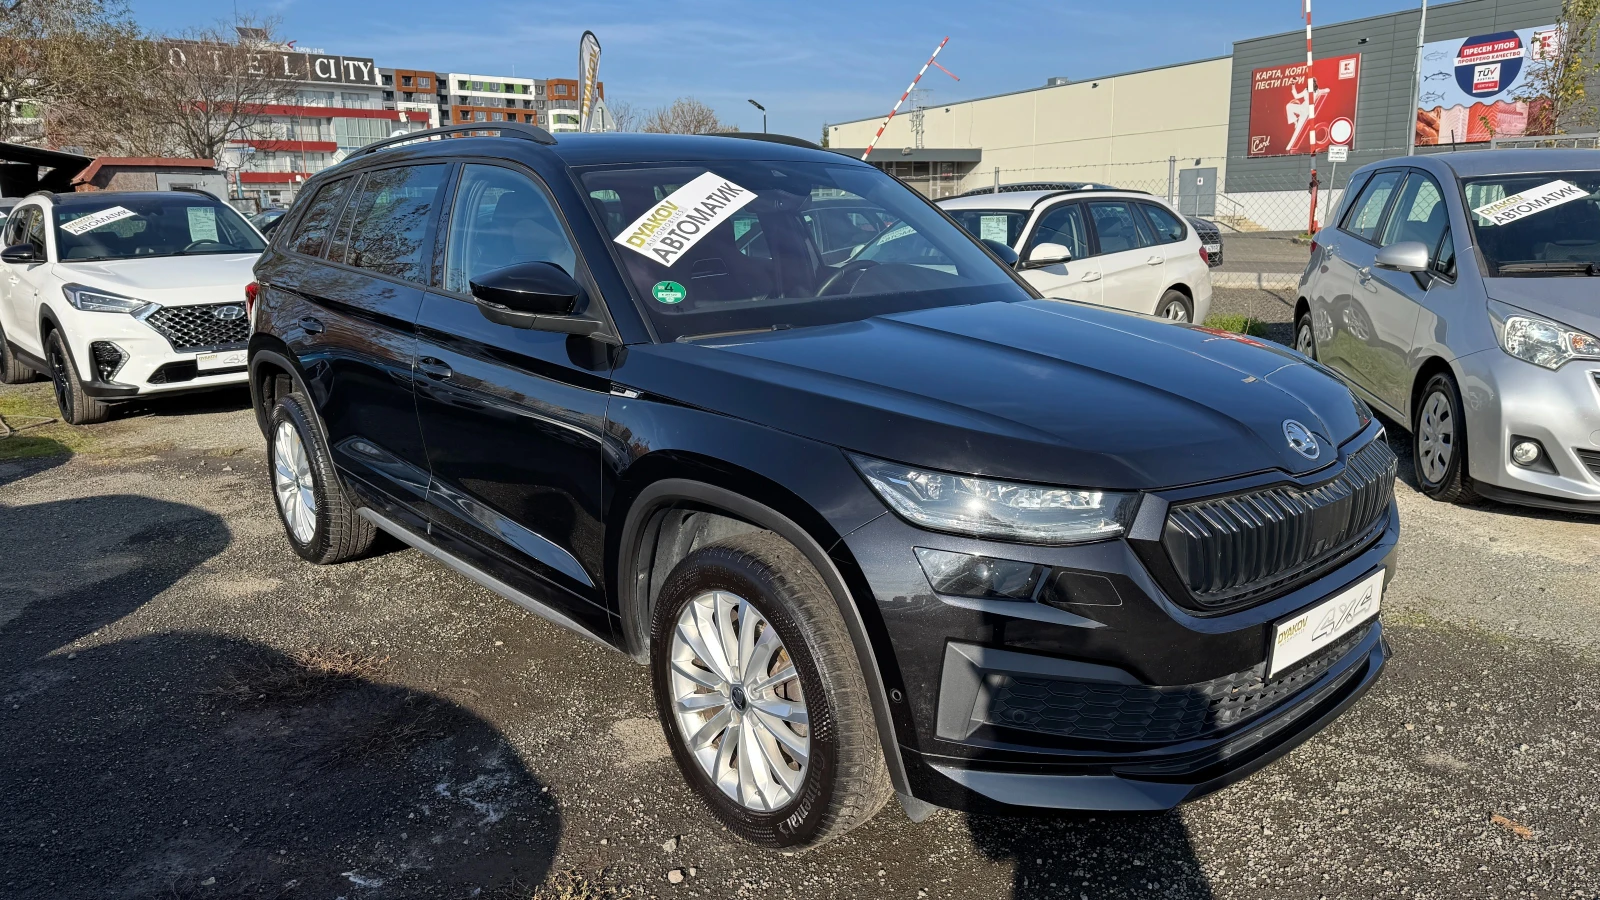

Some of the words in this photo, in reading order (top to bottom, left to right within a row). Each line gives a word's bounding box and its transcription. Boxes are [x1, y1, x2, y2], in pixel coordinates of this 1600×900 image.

[1457, 55, 1491, 65] ПРОВЕРЕНО
[1491, 50, 1521, 60] КАЧЕСТВО
[1463, 45, 1493, 56] ПРЕСЕН
[1493, 41, 1516, 53] УЛОВ
[315, 58, 372, 81] CITY
[1255, 69, 1284, 81] КАРТА,
[1255, 79, 1282, 90] ПЕСТИ
[1253, 135, 1271, 152] Card
[1480, 194, 1524, 216] DYAKOV
[1494, 186, 1580, 224] АВТОМАТИК
[73, 209, 131, 235] АВТОМАТИК
[625, 200, 679, 249] DYAKOV
[646, 209, 684, 247] AUTOMOBILES
[652, 182, 744, 264] АВТОМАТИК
[664, 282, 674, 292] 4
[1277, 615, 1309, 645] DYAKOV
[786, 748, 825, 835] Continental
